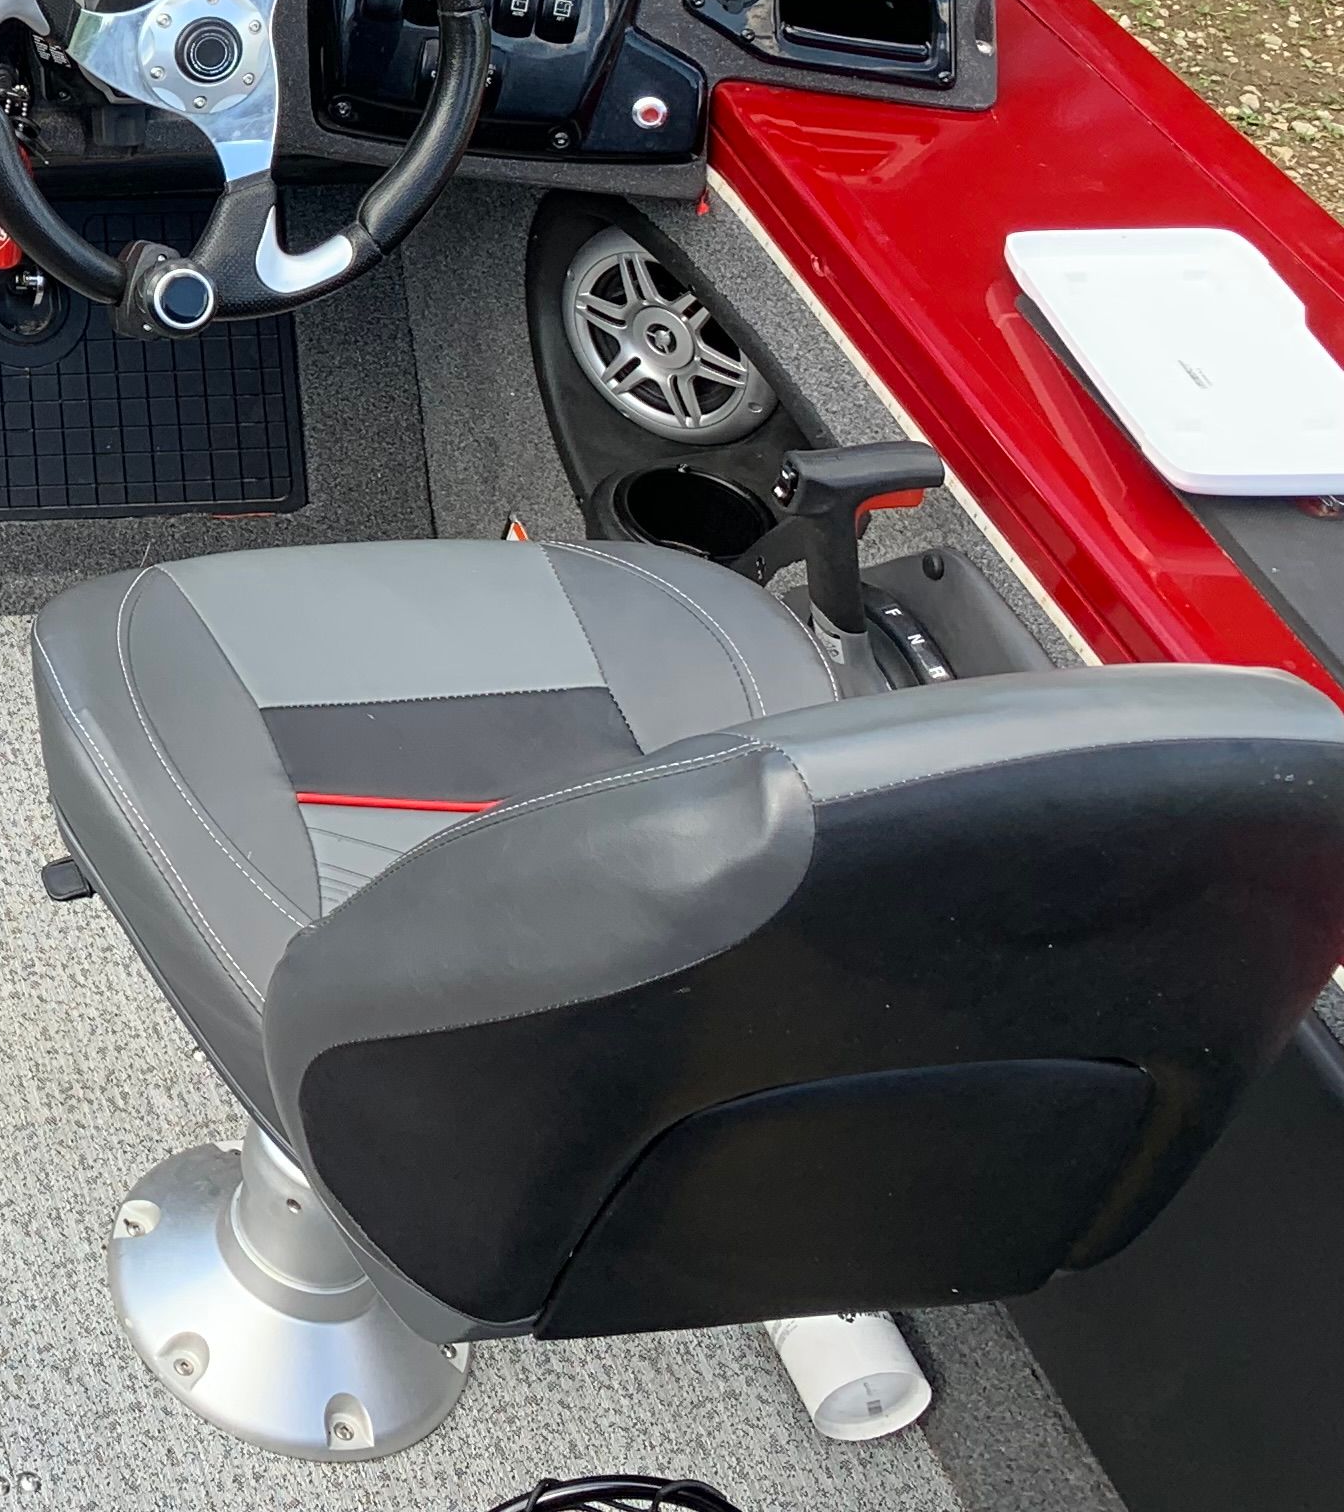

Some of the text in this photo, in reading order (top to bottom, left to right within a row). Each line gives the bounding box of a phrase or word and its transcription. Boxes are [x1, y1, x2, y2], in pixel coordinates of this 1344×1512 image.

[884, 607, 904, 617] F
[907, 633, 926, 646] N
[928, 665, 946, 679] R
